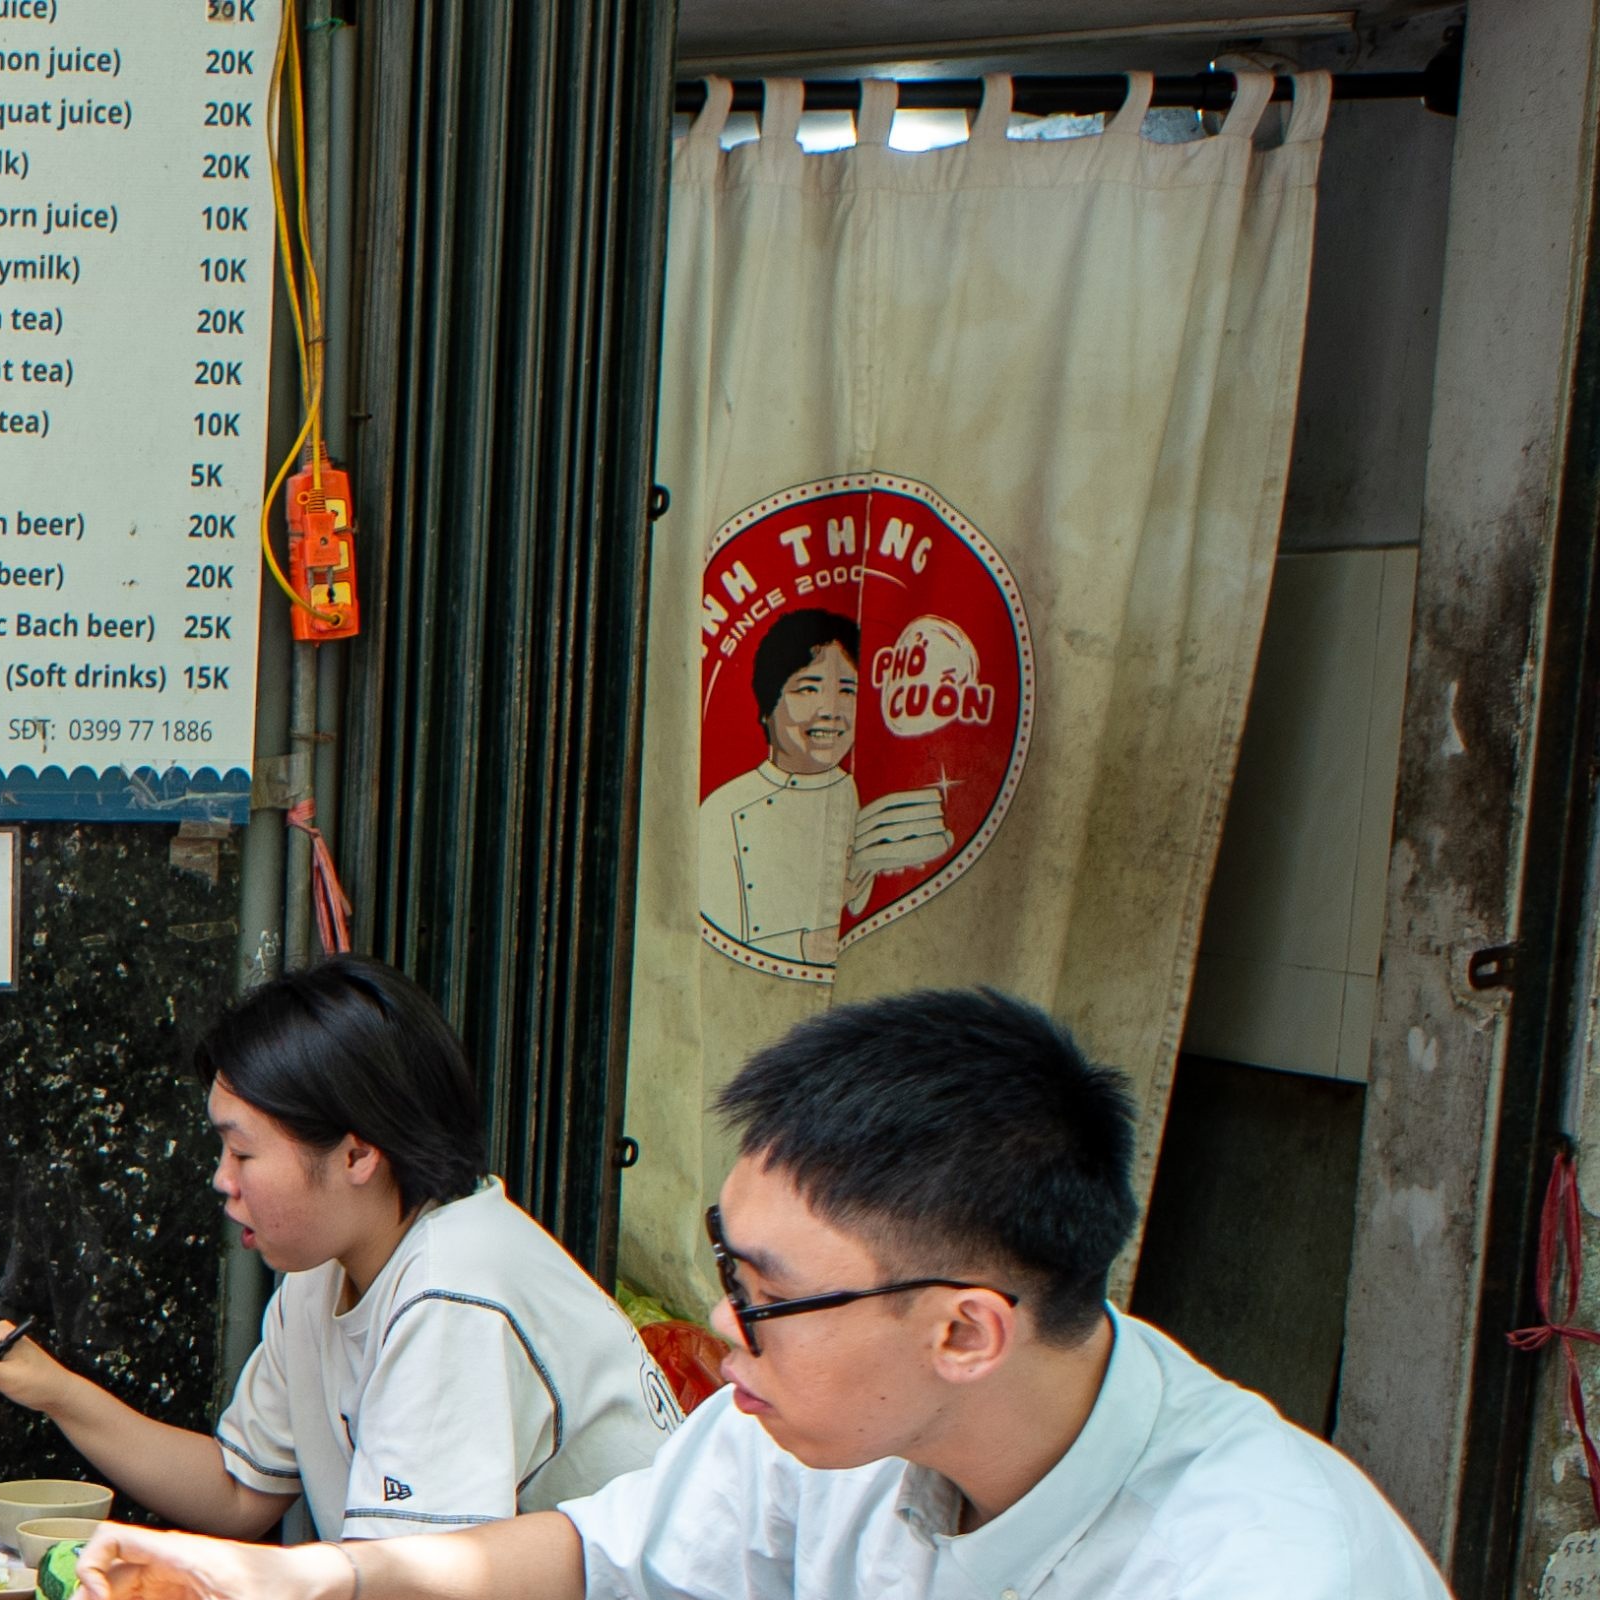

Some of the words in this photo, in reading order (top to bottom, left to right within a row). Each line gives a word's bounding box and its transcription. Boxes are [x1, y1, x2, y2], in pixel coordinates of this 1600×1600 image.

[45, 45, 121, 79] juice)
[205, 48, 254, 76] 20K
[56, 97, 132, 132] juice)
[204, 100, 252, 128] 20K
[202, 153, 251, 180] 20K
[42, 201, 118, 235] juice)
[202, 205, 249, 232] 10K
[200, 257, 247, 284] 10K
[11, 306, 63, 336] tea)
[196, 308, 245, 336] 20K
[21, 359, 73, 389] tea)
[194, 360, 243, 387] 20K
[194, 411, 240, 438] 10K
[190, 462, 223, 488] 5K
[16, 510, 85, 542] beer)
[188, 513, 236, 539] 20K
[779, 515, 933, 574] THNG
[185, 563, 234, 590] 20K
[16, 612, 78, 638] Bach
[87, 611, 155, 644] beer)
[183, 614, 232, 640] 25K
[720, 588, 786, 657] SINCE
[875, 631, 928, 684] PHỞ
[6, 661, 67, 693] (Soft
[74, 662, 167, 694] drinks)
[183, 665, 230, 691] 15K
[68, 718, 122, 742] 0399
[128, 719, 155, 742] 77
[161, 719, 214, 743] 1886
